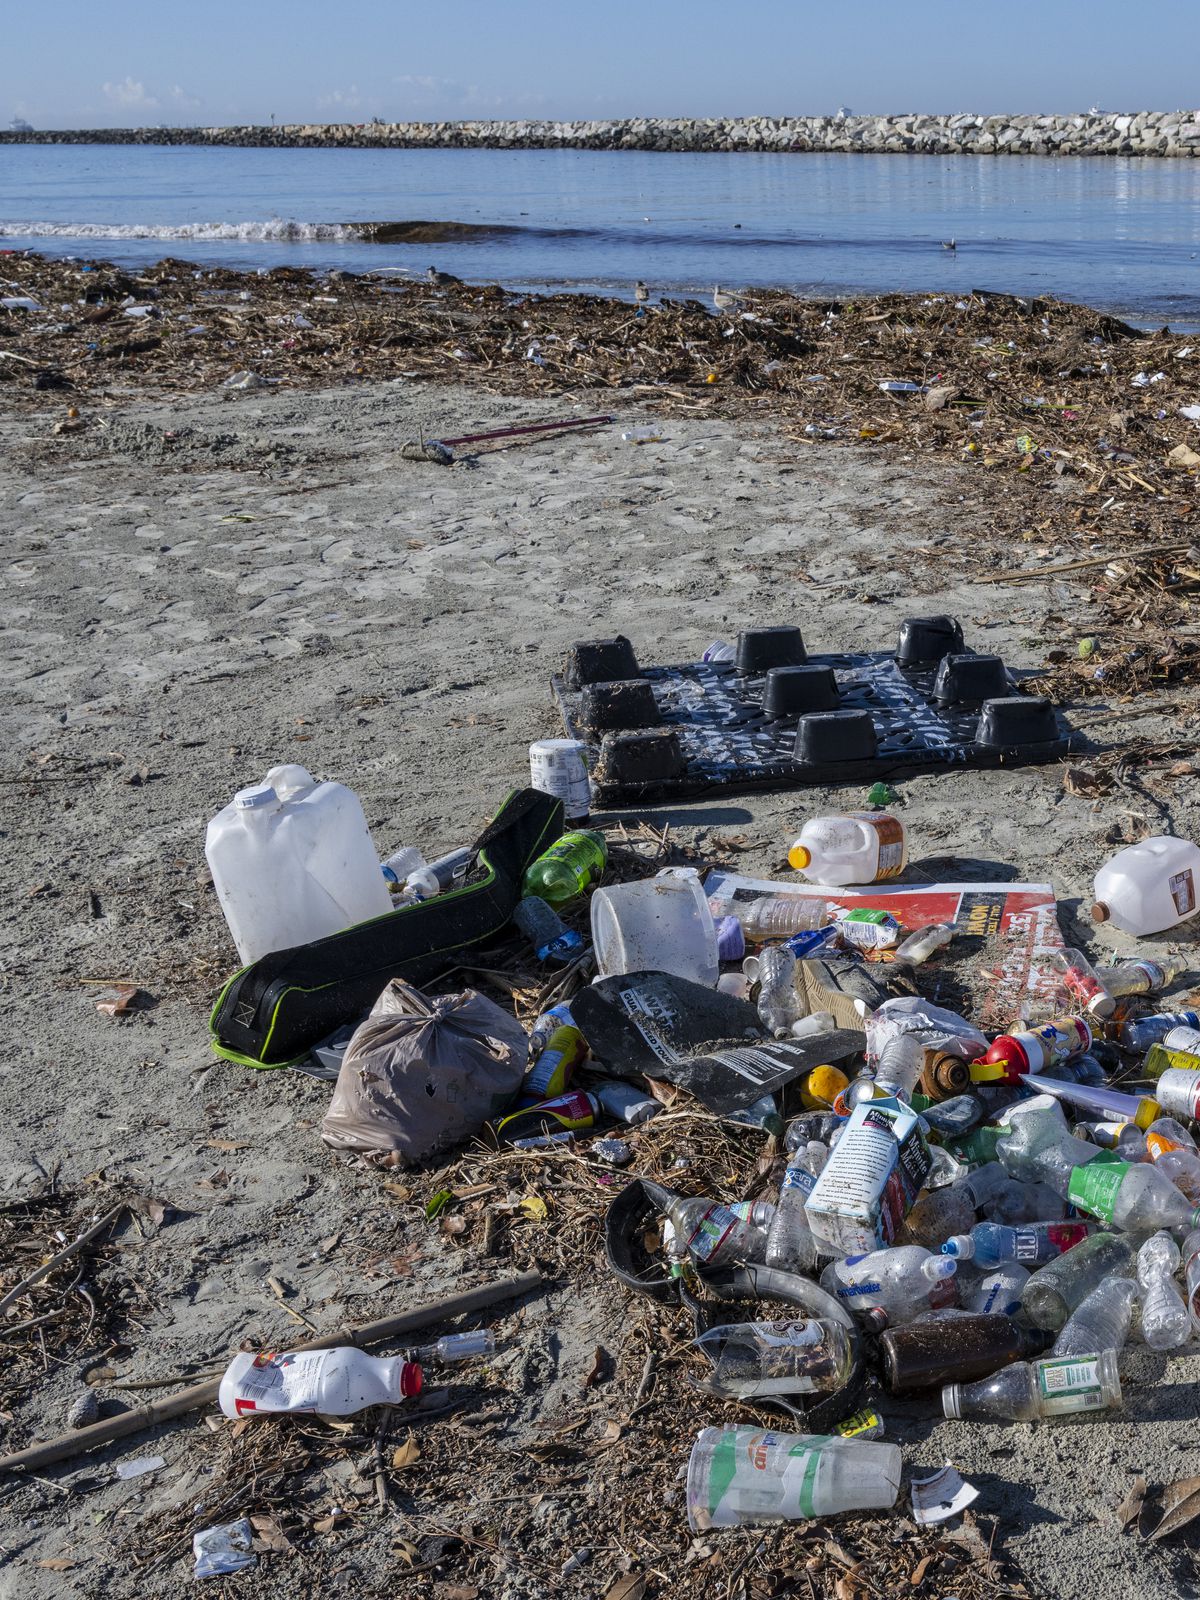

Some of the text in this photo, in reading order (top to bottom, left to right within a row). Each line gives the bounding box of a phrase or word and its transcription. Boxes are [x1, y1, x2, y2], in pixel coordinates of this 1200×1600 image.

[655, 1045, 674, 1065] TOUG
[901, 1147, 920, 1180] Maid
[907, 1133, 930, 1177] Minute
[837, 1282, 882, 1299] smartwater
[1046, 1369, 1056, 1389] GOLD
[1055, 1368, 1065, 1388] PEAK
